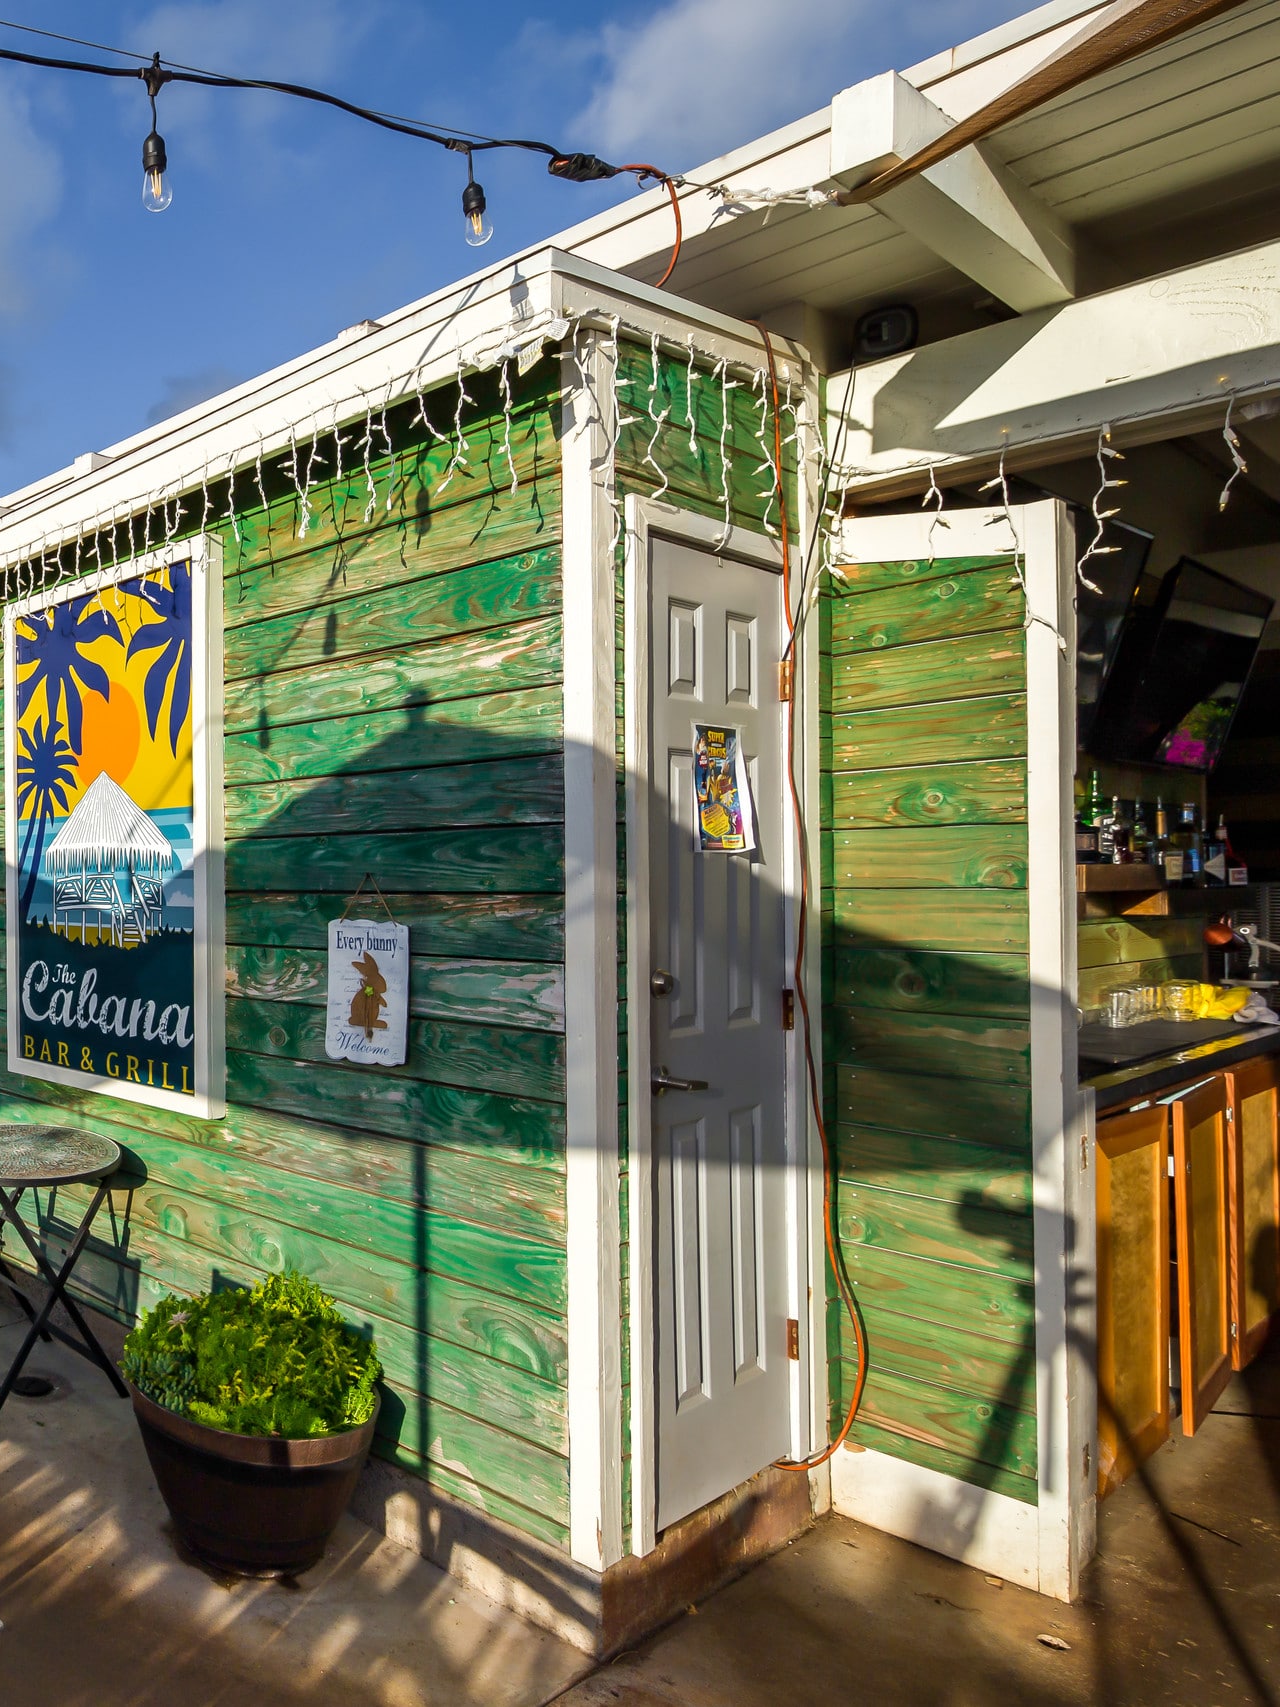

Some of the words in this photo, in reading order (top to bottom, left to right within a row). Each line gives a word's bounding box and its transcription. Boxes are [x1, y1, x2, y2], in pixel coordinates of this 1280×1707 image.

[336, 930, 365, 956] Every
[366, 931, 398, 958] bunny
[52, 964, 77, 984] The
[22, 960, 194, 1048] Cabana
[336, 1031, 390, 1056] Welcome
[24, 1034, 70, 1067] BAR
[80, 1046, 95, 1073] &
[106, 1051, 194, 1094] GRILL
